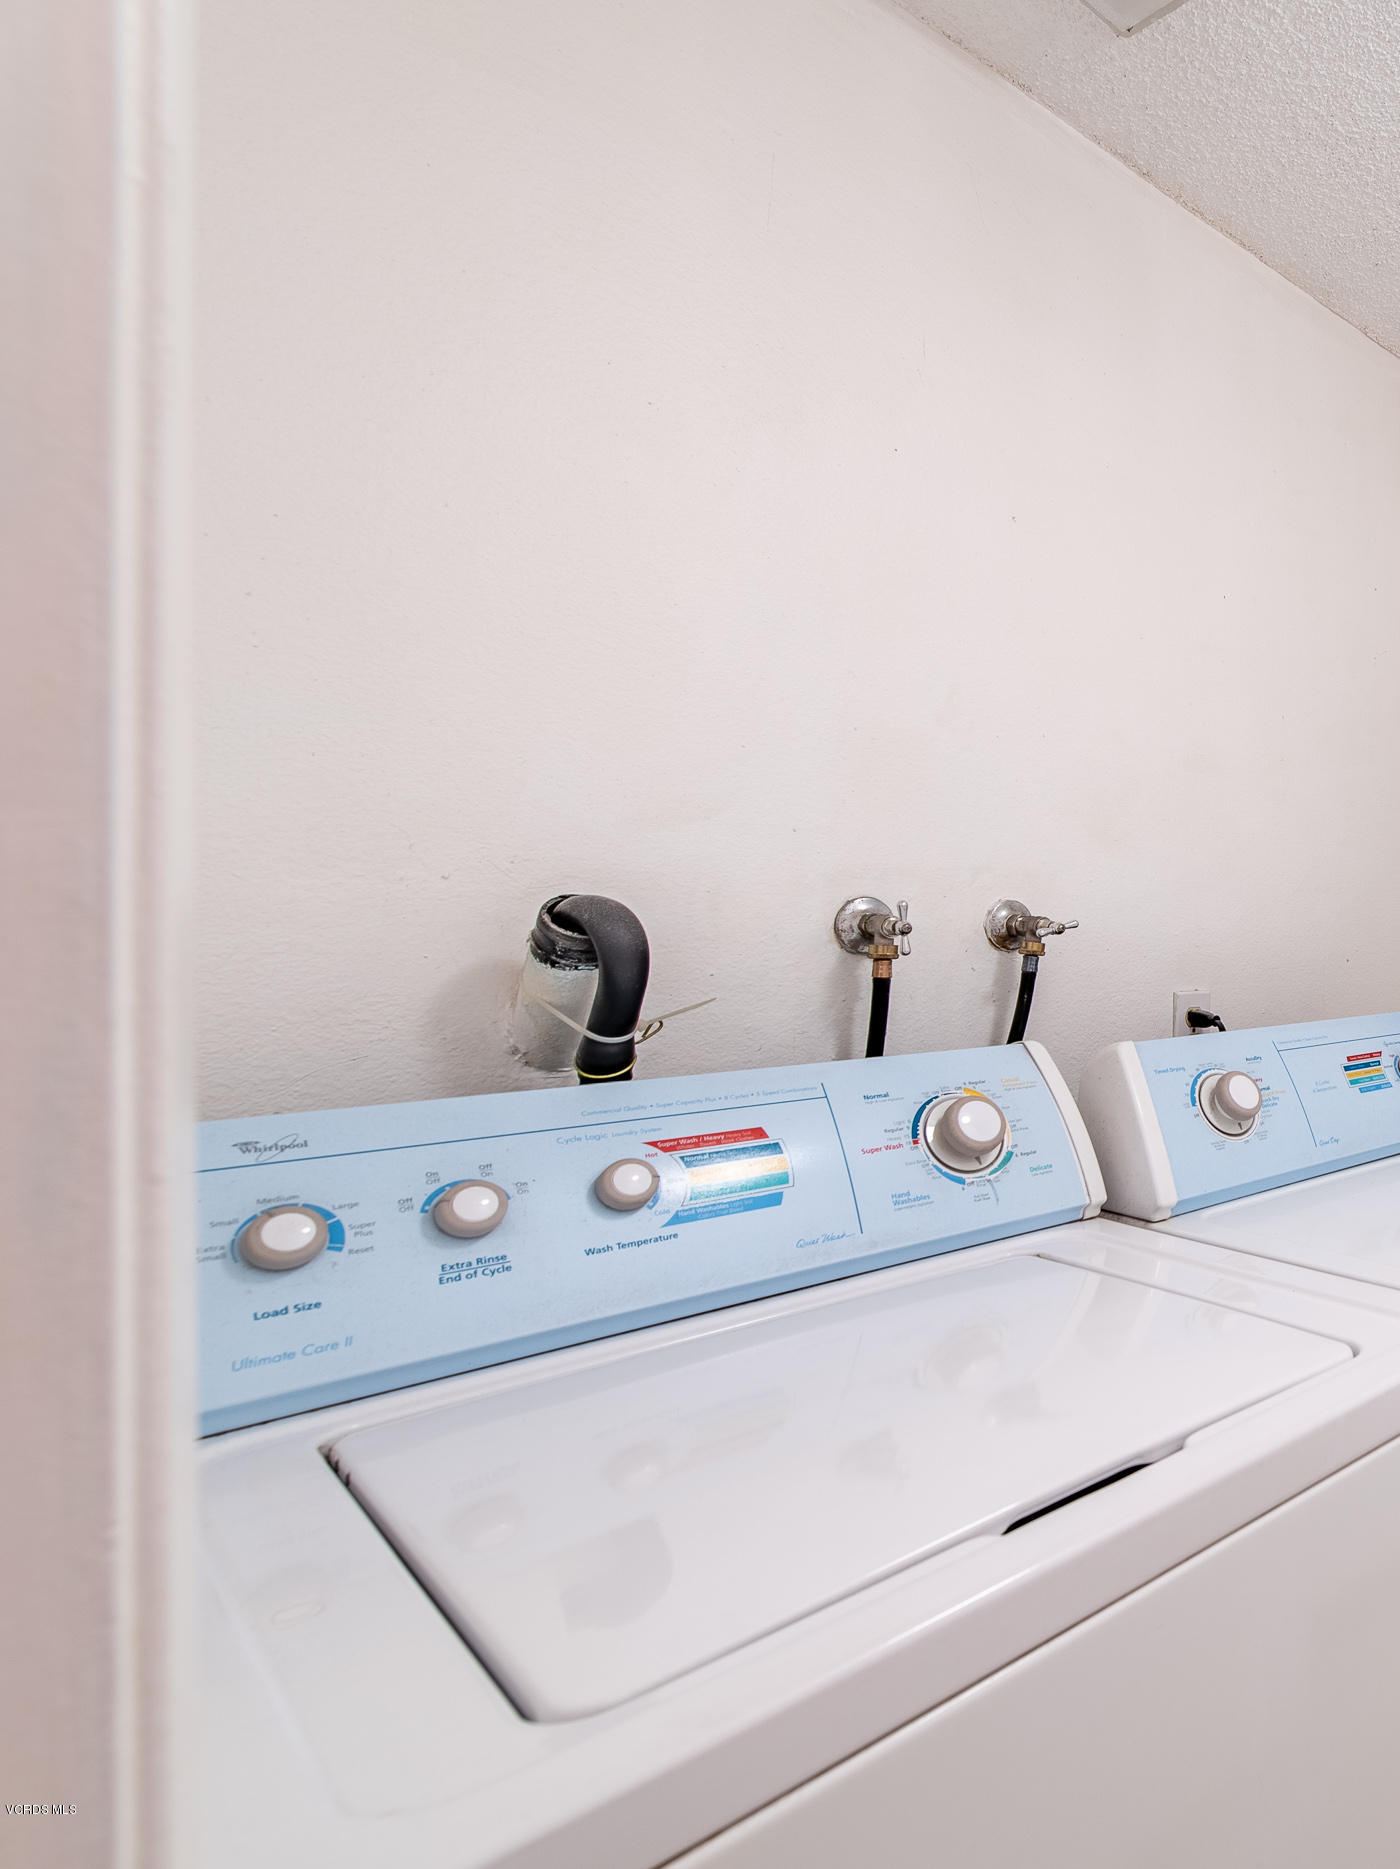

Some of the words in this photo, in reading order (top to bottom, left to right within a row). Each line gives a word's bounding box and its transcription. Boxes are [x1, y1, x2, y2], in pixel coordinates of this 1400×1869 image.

[863, 1091, 890, 1100] Normal
[556, 1135, 583, 1145] Cycle
[585, 1132, 609, 1141] Logic
[657, 1140, 678, 1149] Super
[679, 1136, 699, 1145] Wash
[703, 1134, 726, 1142] Heavy
[231, 1136, 308, 1159] Whirlpool
[884, 1142, 904, 1151] Wash
[683, 1154, 710, 1163] Normal
[1029, 1163, 1053, 1173] Delicate
[891, 1190, 911, 1199] Hand
[892, 1194, 931, 1206] Washables
[331, 1201, 361, 1211] Large
[208, 1218, 240, 1229] Small
[348, 1220, 377, 1232] Super
[353, 1229, 374, 1239] Plus
[348, 1244, 375, 1256] Reset
[584, 1244, 614, 1257] Wash
[616, 1231, 679, 1251] Temperature
[440, 1260, 473, 1273] Extra
[475, 1253, 508, 1266] Rinse
[438, 1273, 462, 1286] End
[465, 1270, 478, 1281] of
[481, 1263, 513, 1279] Cycle
[253, 1305, 289, 1322] Load
[293, 1301, 323, 1314] Size
[231, 1350, 297, 1373] Ultimate
[301, 1341, 340, 1357] Care
[344, 1335, 354, 1348] II
